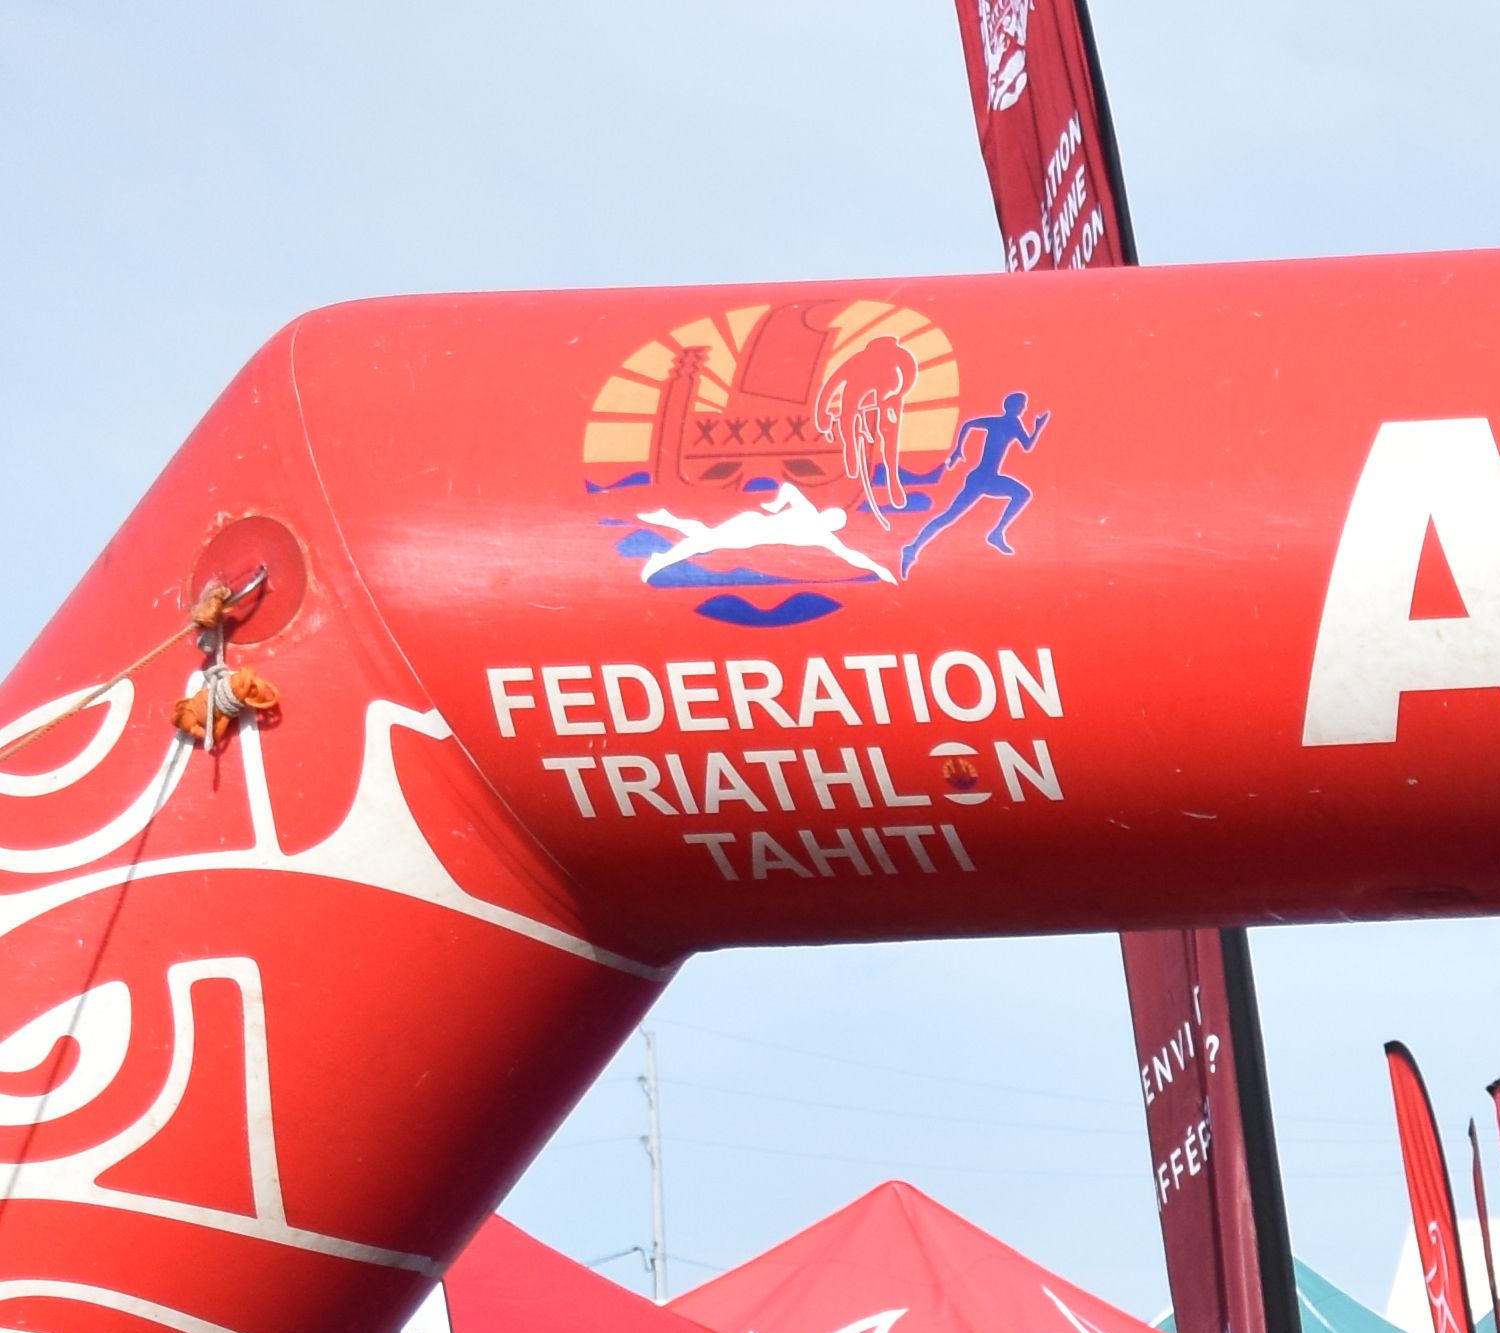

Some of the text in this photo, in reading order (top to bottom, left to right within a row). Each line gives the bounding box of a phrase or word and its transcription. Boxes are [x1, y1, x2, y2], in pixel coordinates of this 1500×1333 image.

[486, 647, 1064, 738] FEDERATION
[541, 740, 1064, 818] TRIATHLON
[684, 824, 977, 881] TAHITI
